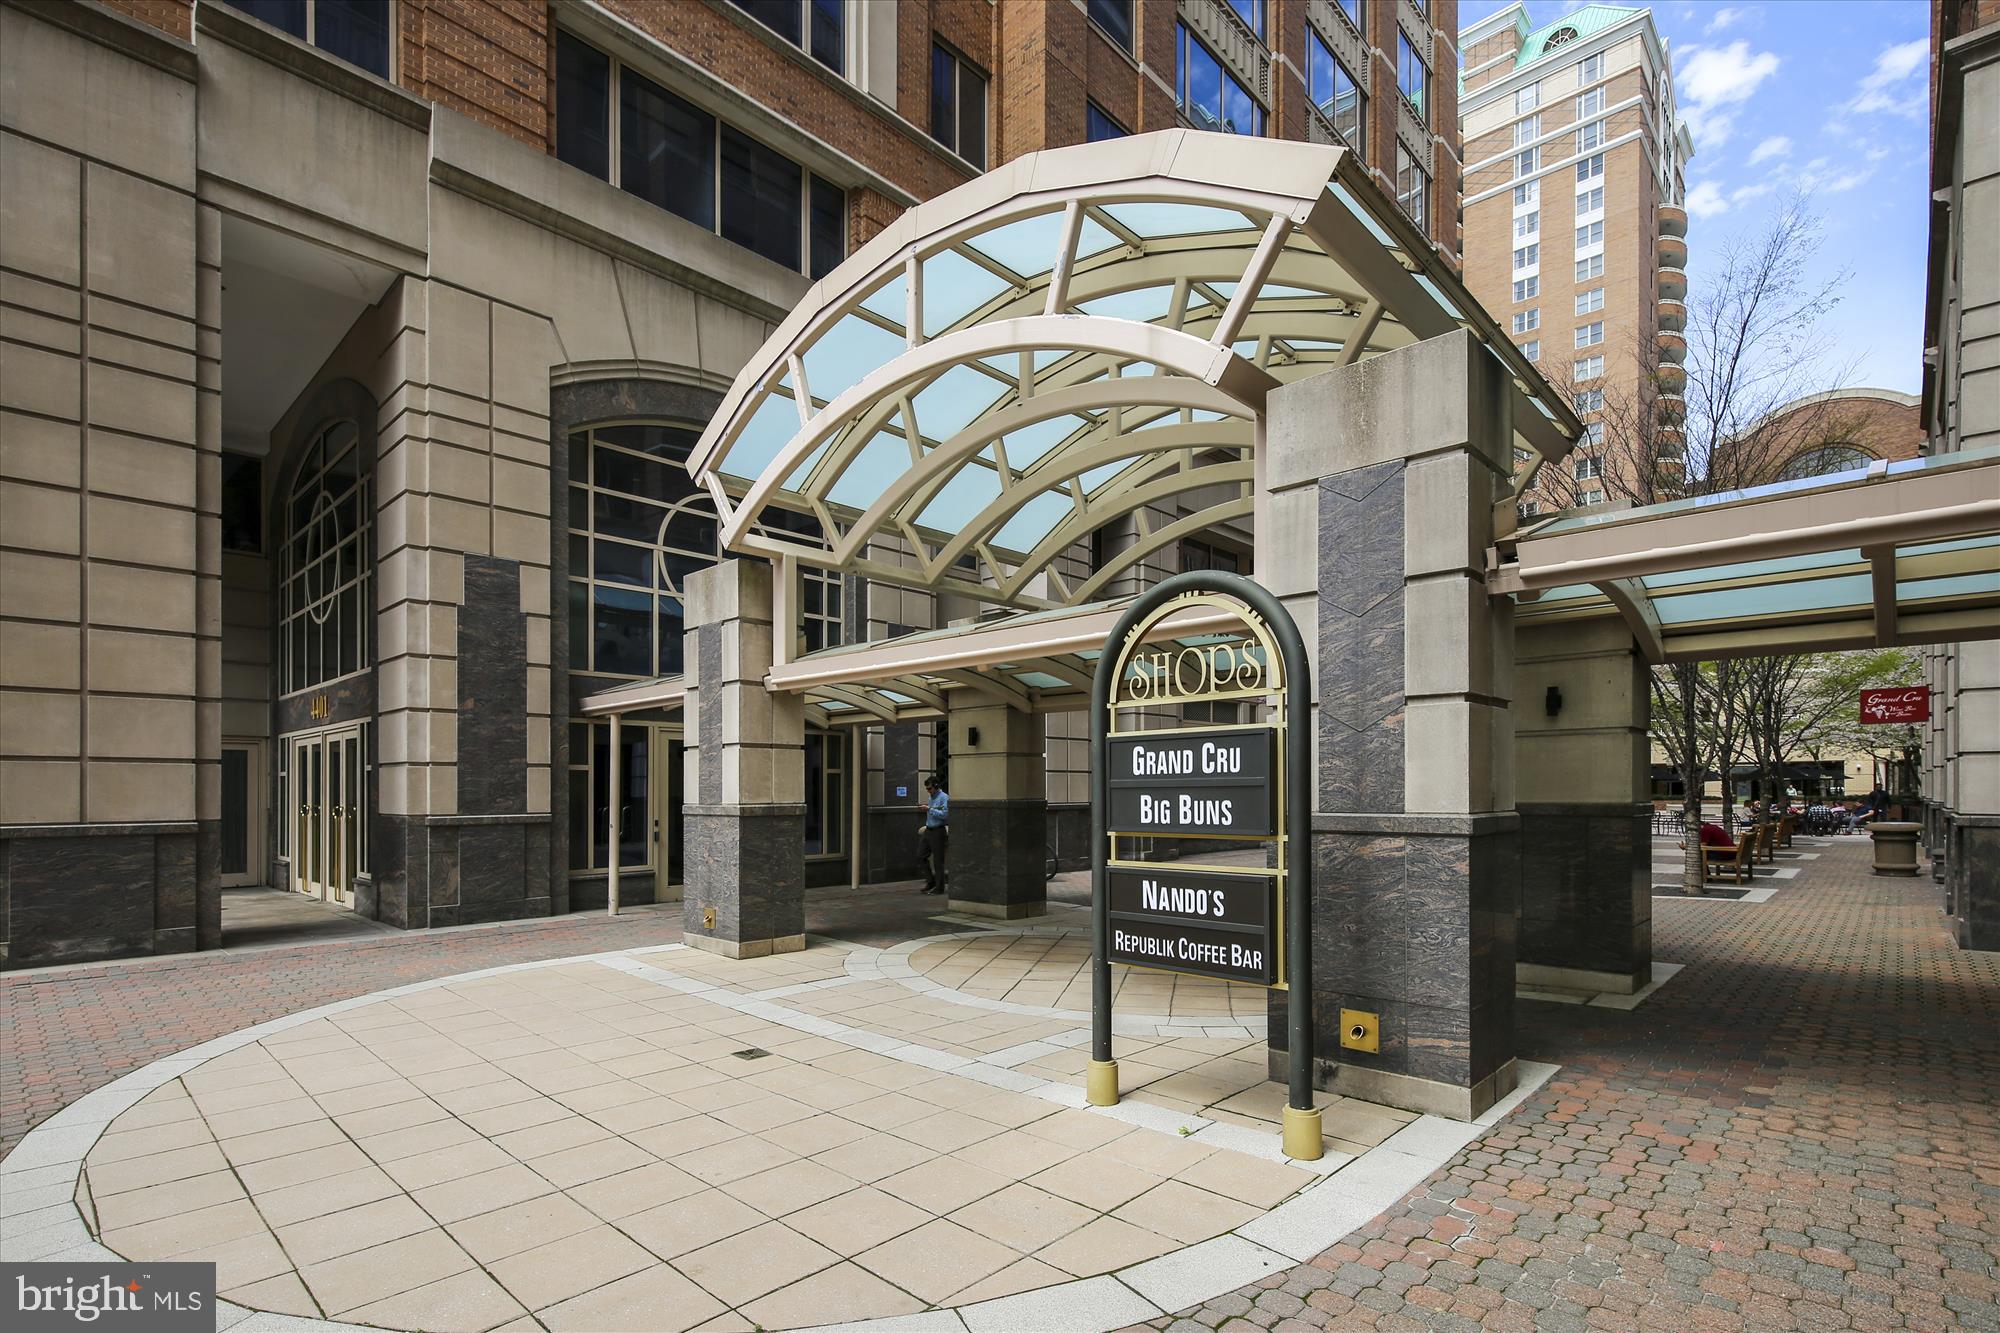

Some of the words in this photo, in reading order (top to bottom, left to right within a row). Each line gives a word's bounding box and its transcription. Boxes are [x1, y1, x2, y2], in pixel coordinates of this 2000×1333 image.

[1129, 637, 1260, 700] SHOPS
[311, 695, 328, 720] 4401
[1868, 693, 1902, 706] Grand
[1903, 691, 1922, 702] Cru
[1133, 745, 1194, 775] GRAND
[1202, 742, 1241, 773] CRU
[1140, 794, 1171, 825] BIG
[1179, 794, 1232, 826] BUNS
[1142, 880, 1225, 917] NANDO'S
[1115, 930, 1175, 959] REPUBLIK
[1178, 937, 1228, 965] COFFEE
[1231, 944, 1263, 970] BAR
